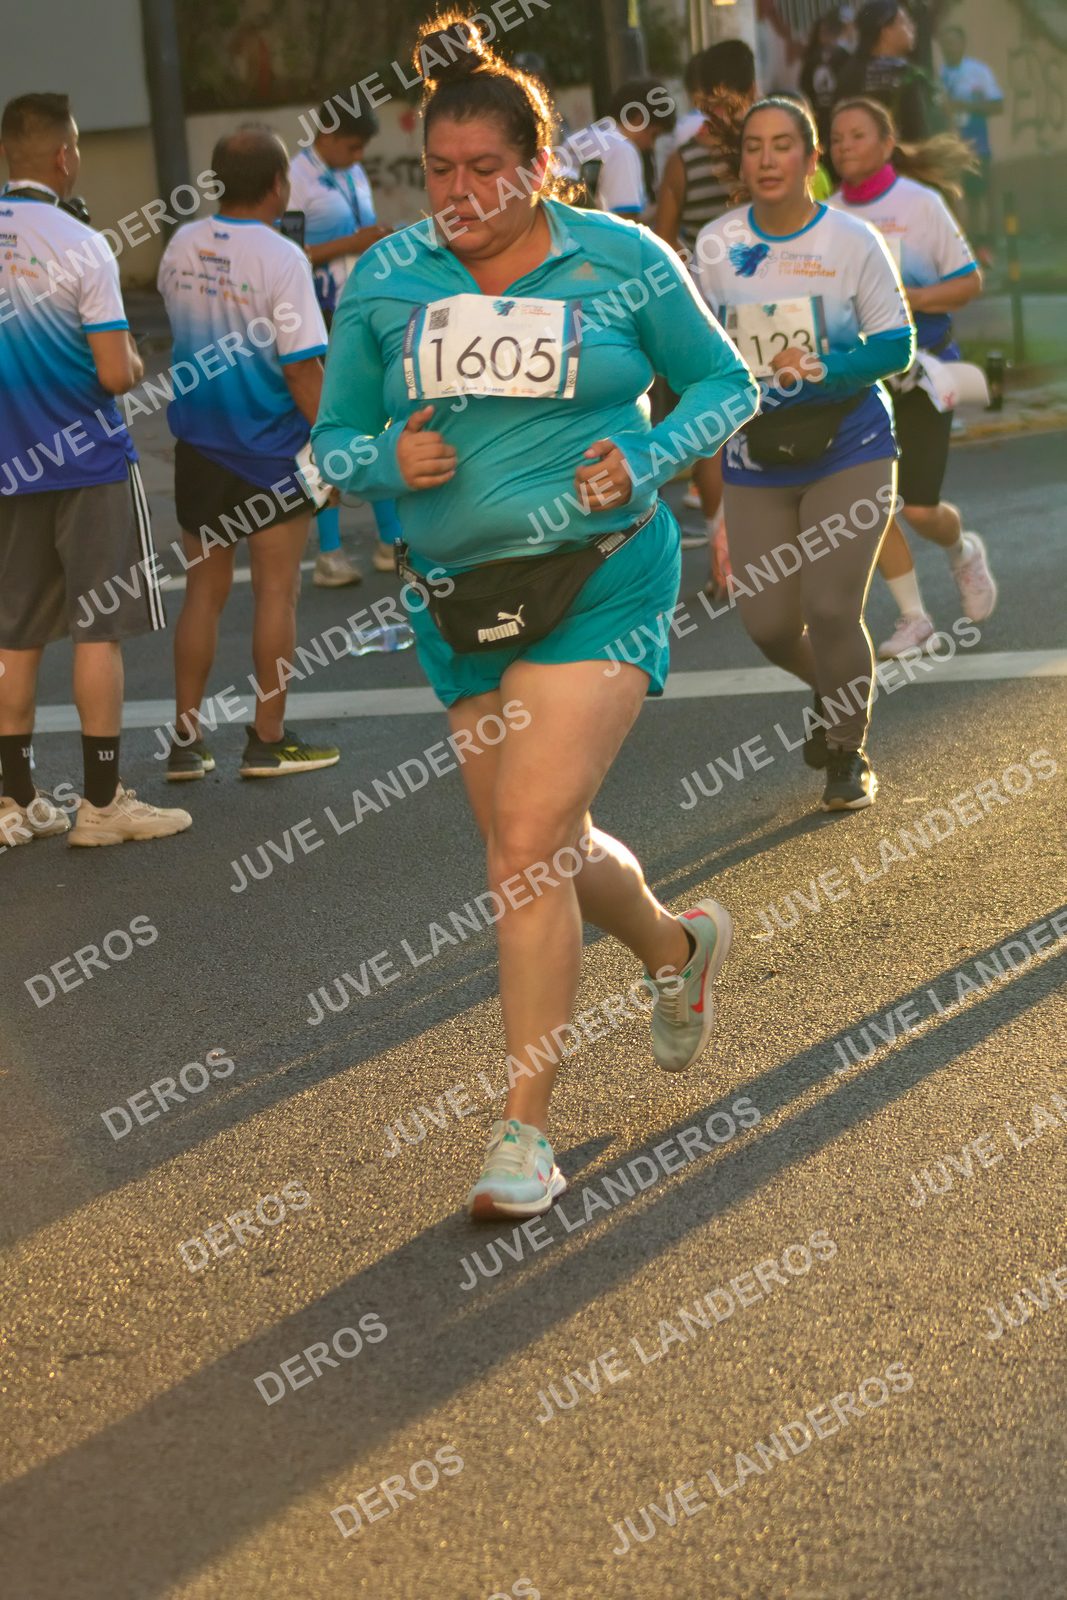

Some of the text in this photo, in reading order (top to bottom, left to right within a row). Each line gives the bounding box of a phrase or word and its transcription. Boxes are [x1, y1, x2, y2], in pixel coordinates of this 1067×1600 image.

[425, 336, 556, 382] 1605
[566, 369, 577, 389] 1605
[477, 620, 520, 643] PUMA
